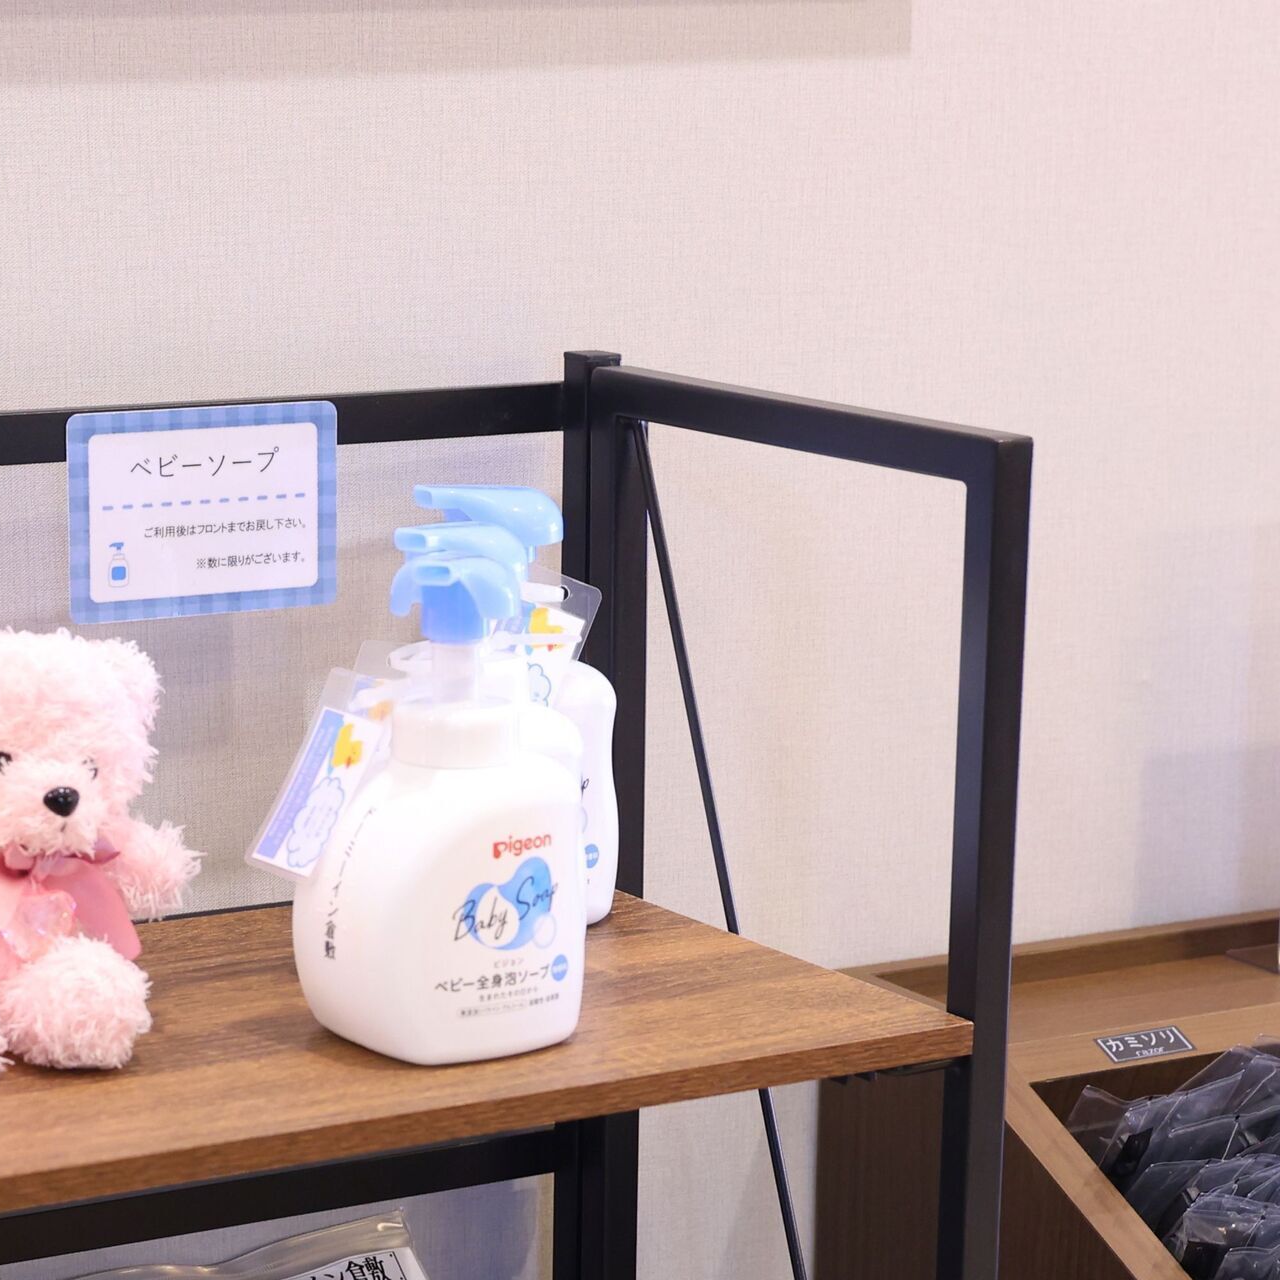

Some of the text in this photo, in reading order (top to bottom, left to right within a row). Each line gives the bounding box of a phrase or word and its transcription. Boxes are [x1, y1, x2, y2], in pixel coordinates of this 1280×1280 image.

[130, 446, 280, 478] ベビーソープ
[143, 516, 307, 538] ご利用後はフロントまでお戻し下さい。
[195, 549, 306, 570] ※数に限りがございます。
[452, 875, 559, 942] Baby Soap
[434, 963, 551, 993] ベビー全身泡ソープ
[1106, 1029, 1175, 1053] カミソリ
